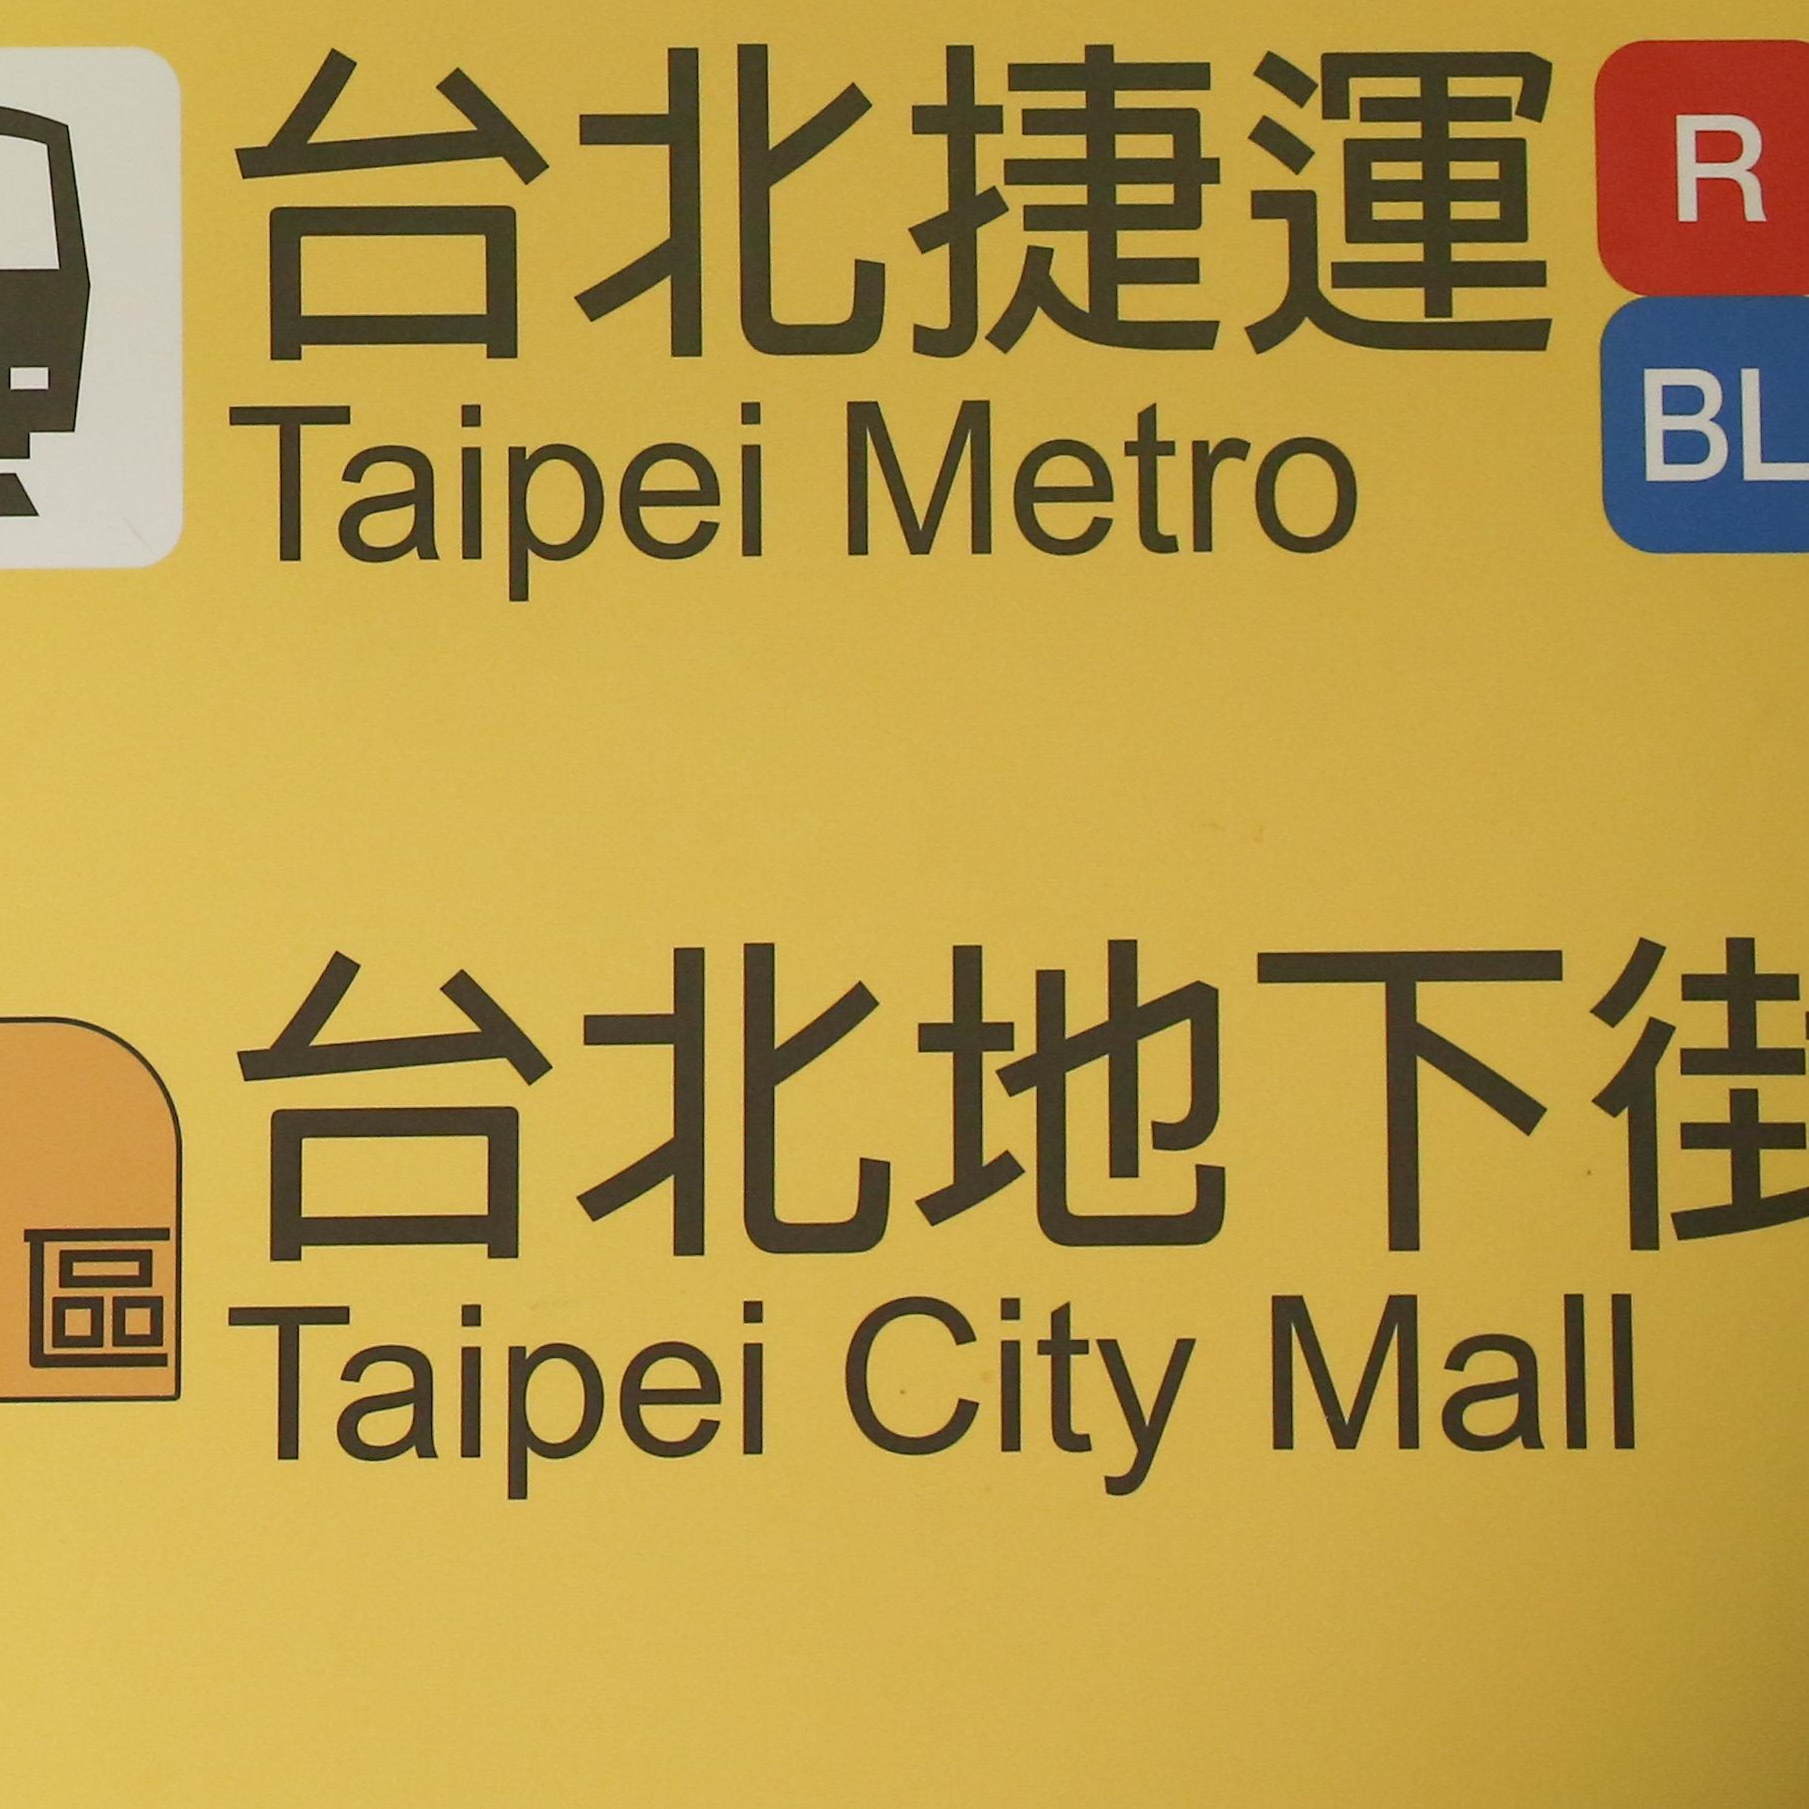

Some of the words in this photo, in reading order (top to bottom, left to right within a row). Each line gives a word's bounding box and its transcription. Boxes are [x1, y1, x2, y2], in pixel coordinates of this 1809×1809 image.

[235, 44, 1552, 360] 台北捷運
[1676, 115, 1766, 221] R
[229, 400, 763, 602] Taipei
[847, 400, 1357, 555] Metro
[1644, 369, 1809, 481] BL
[24, 1228, 170, 1368] 區
[228, 1300, 763, 1500] Taipei
[845, 1296, 1196, 1496] City
[1272, 1294, 1635, 1451] Mall
